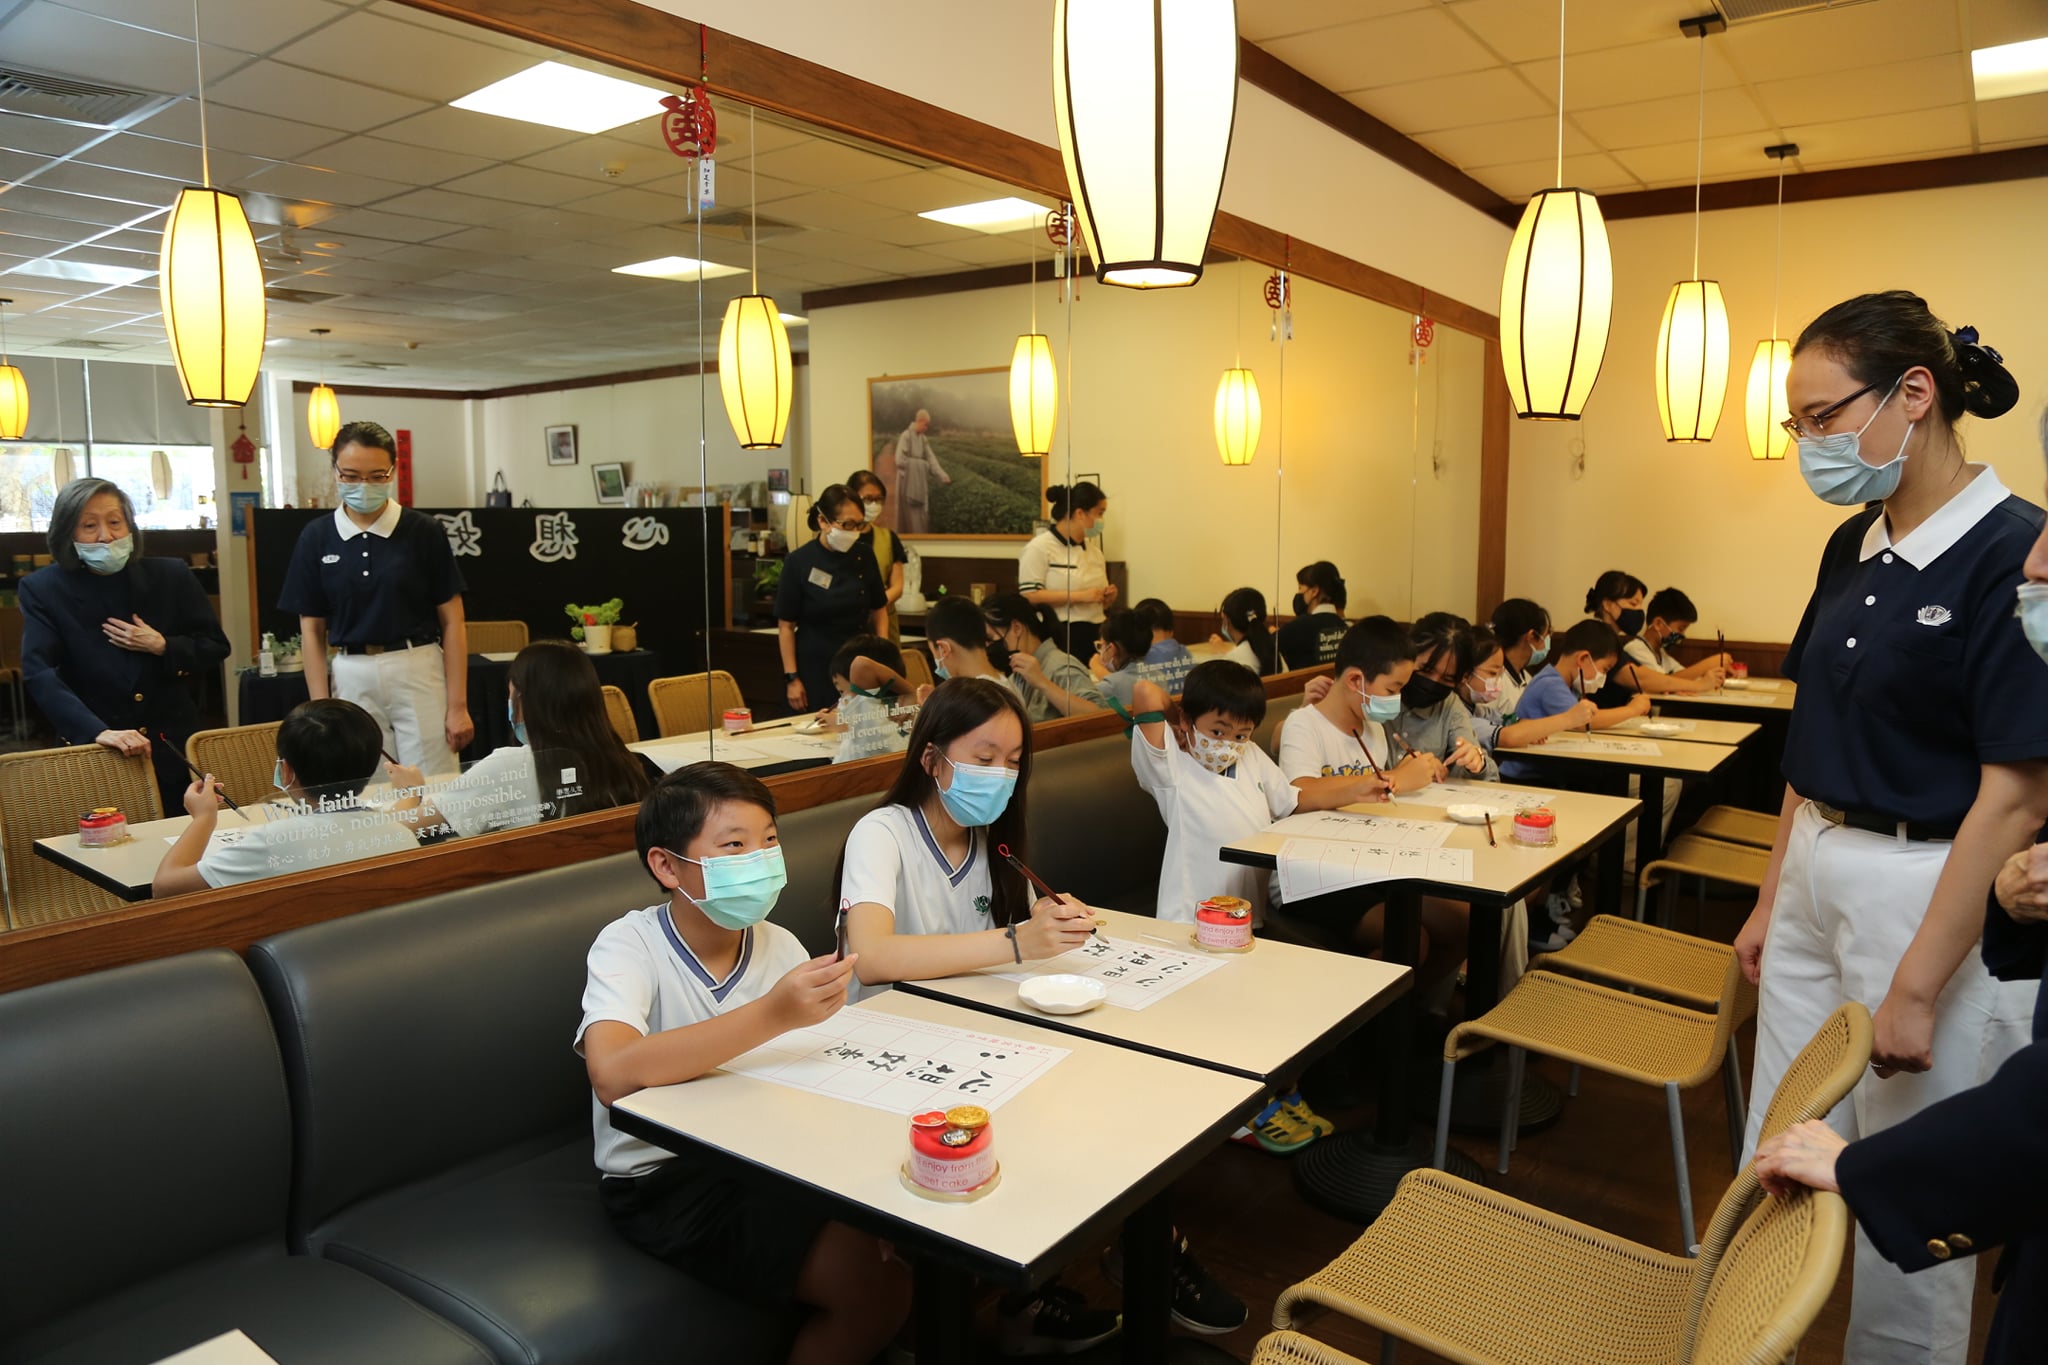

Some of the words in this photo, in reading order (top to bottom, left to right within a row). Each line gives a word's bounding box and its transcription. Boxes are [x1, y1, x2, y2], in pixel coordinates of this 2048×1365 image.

[853, 704, 889, 725] grateful
[262, 798, 313, 822] With
[317, 789, 366, 814] faith,
[370, 770, 496, 806] determination,
[500, 766, 529, 784] and
[265, 818, 344, 847] courage,
[350, 804, 419, 831] nothing
[423, 801, 436, 818] is
[438, 784, 527, 817] impossible.
[921, 1160, 948, 1173] enjoy
[941, 1179, 969, 1188] cake
